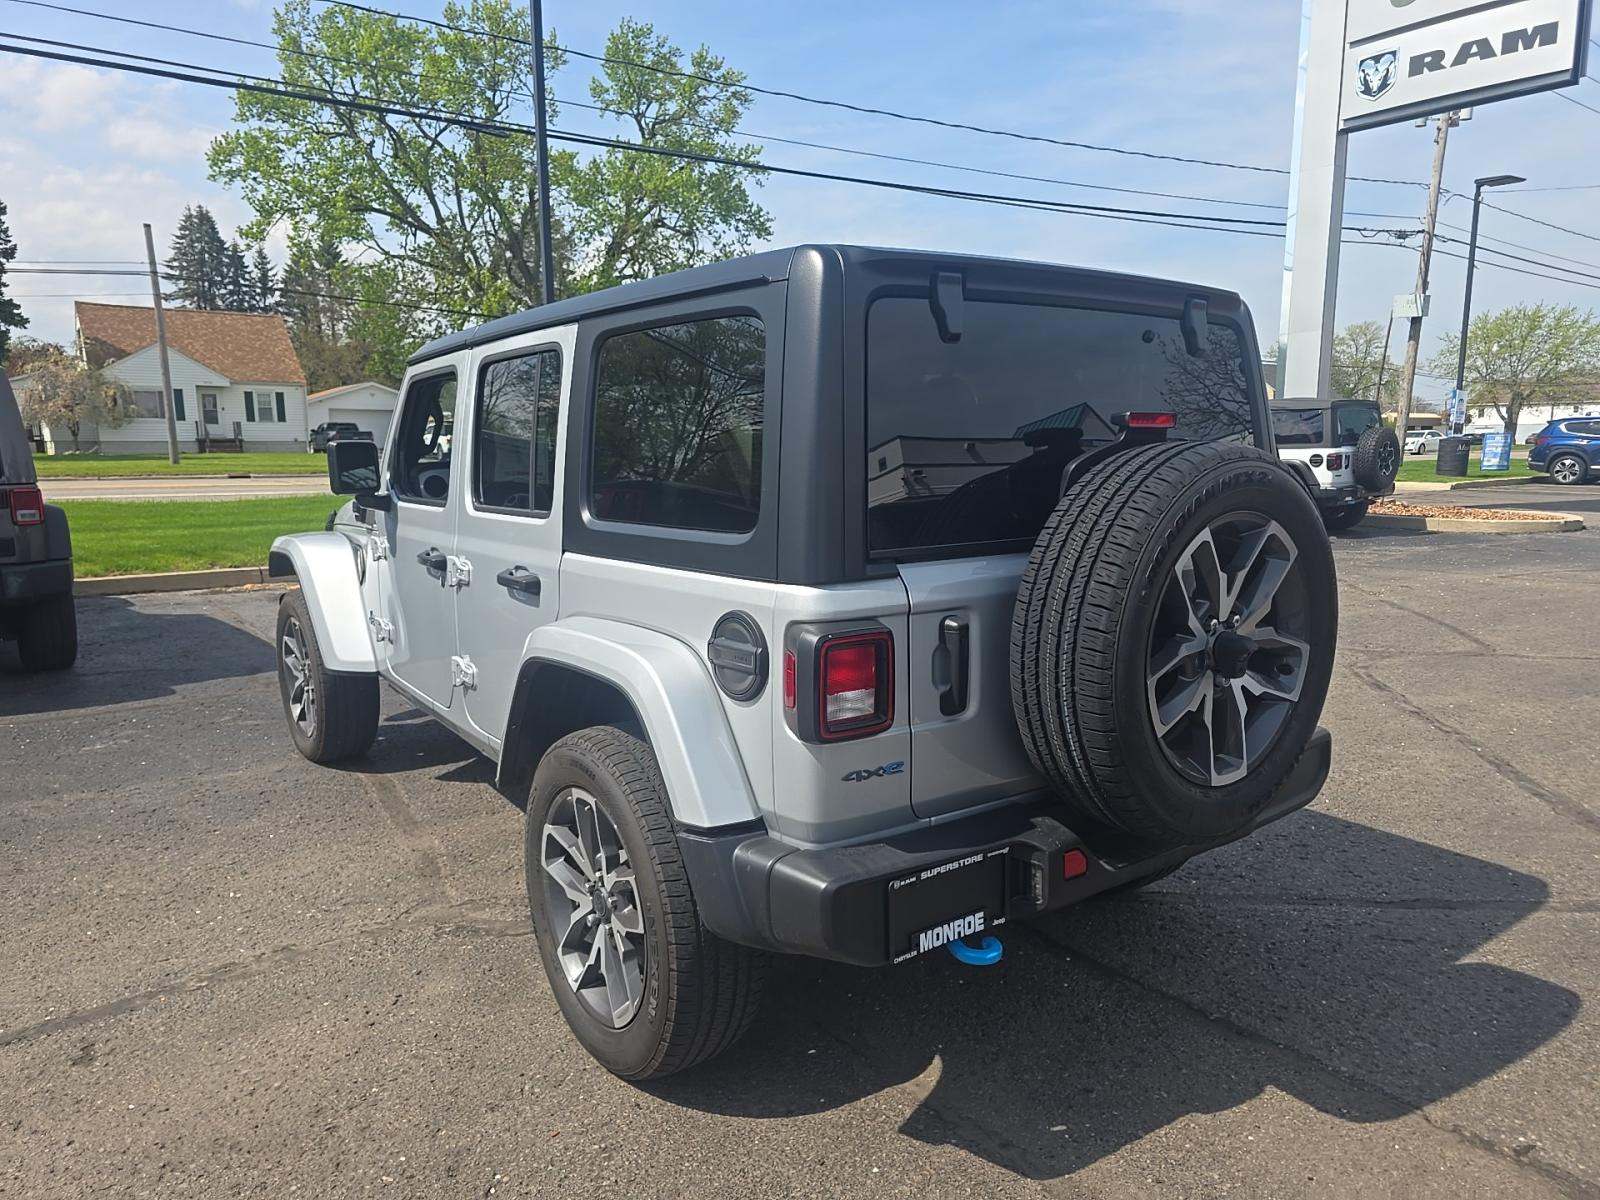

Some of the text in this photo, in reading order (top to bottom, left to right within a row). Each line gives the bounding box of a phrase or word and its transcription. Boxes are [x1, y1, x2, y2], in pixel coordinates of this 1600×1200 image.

[1408, 21, 1559, 78] RAM
[920, 853, 984, 880] SUPERSTORE
[919, 911, 985, 953] MONROE
[992, 917, 1006, 926] Jeep
[893, 950, 918, 964] CHRYSLER
